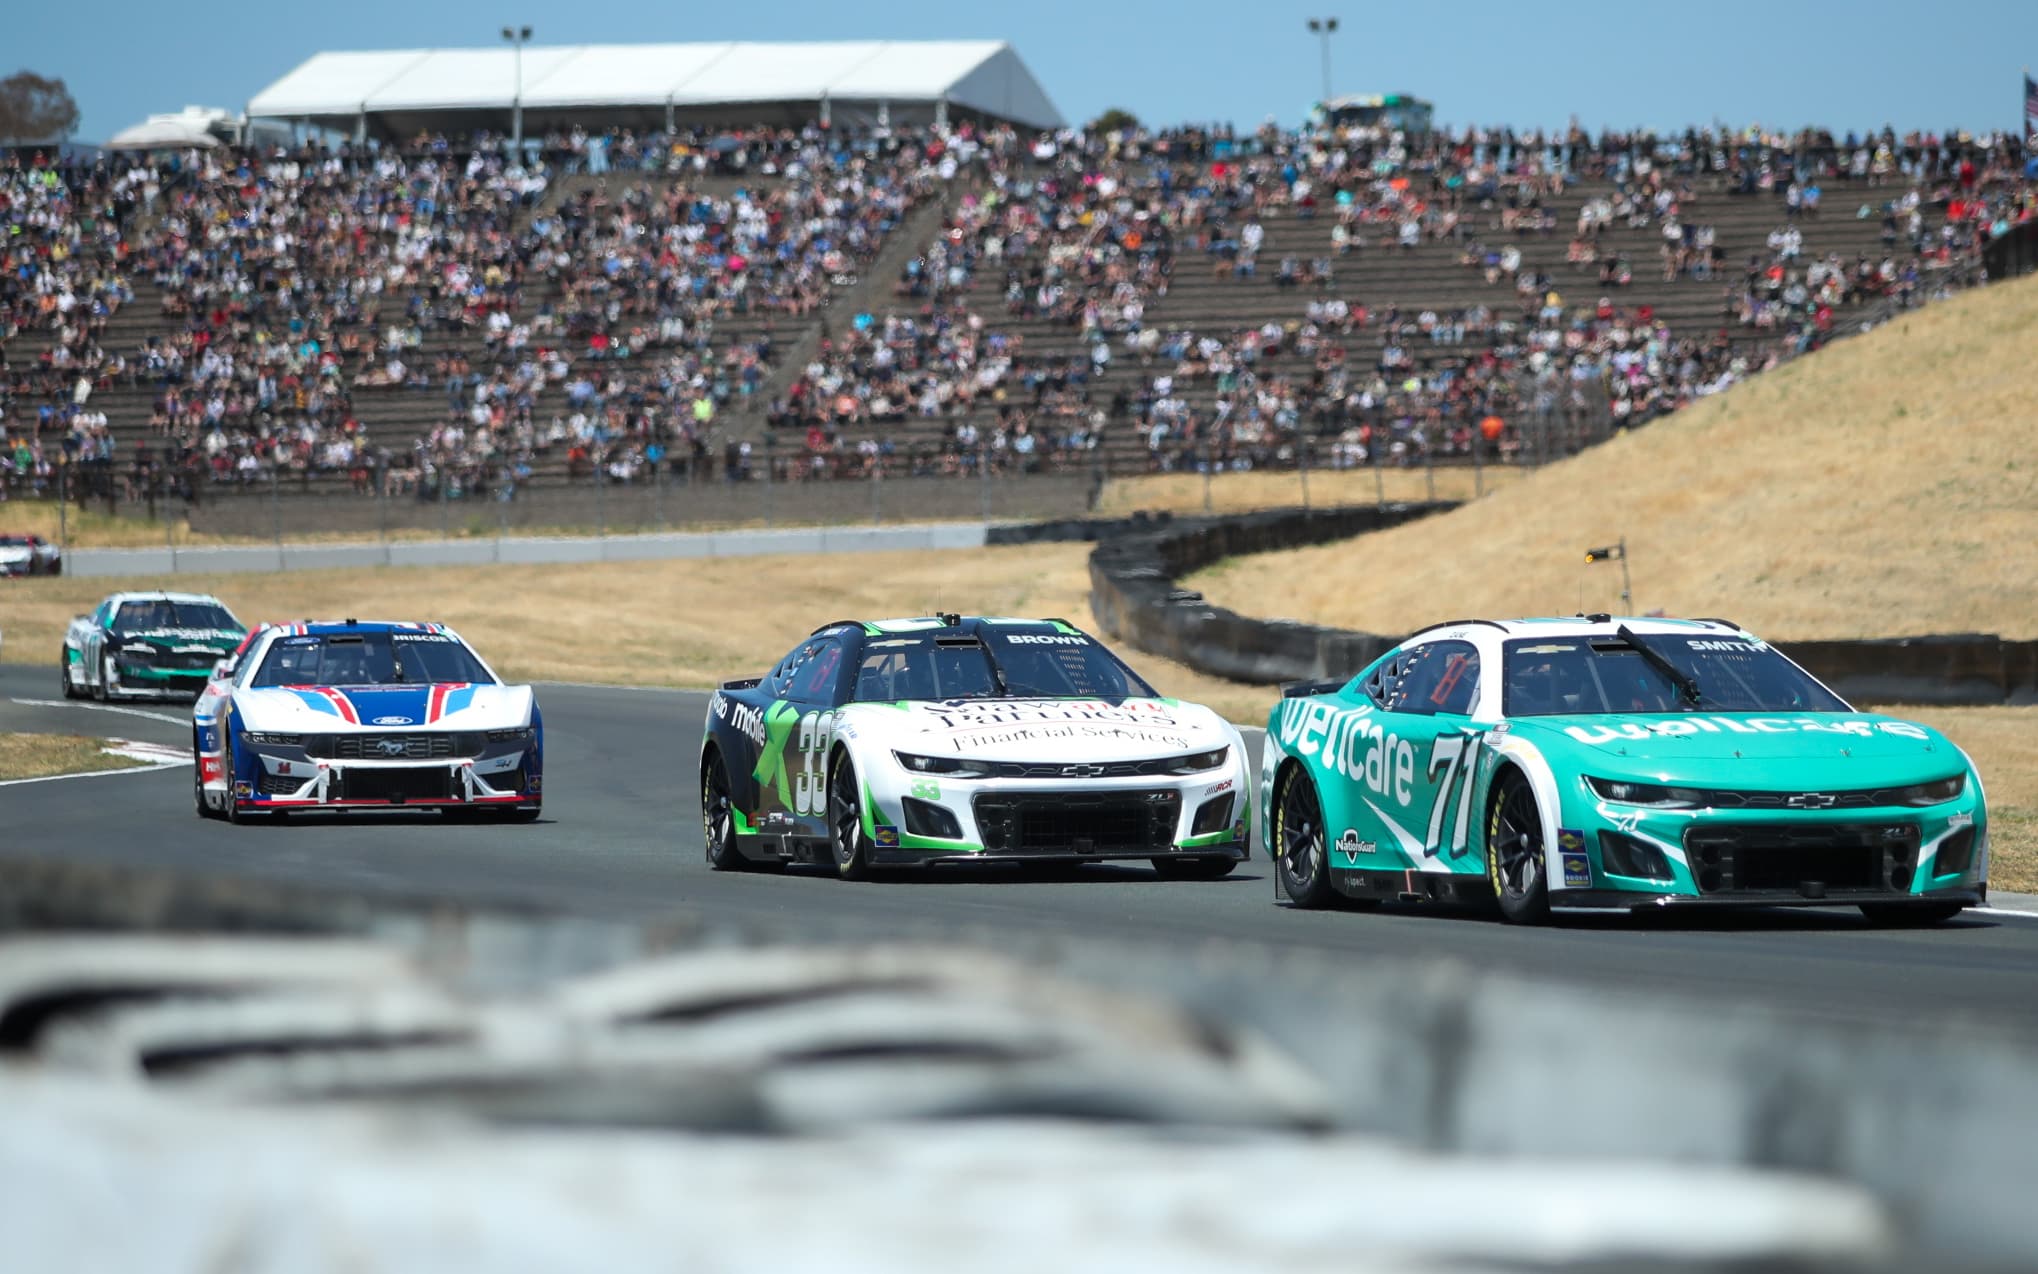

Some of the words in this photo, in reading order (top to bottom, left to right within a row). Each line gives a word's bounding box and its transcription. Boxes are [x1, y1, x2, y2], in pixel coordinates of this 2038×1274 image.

[1006, 634, 1089, 645] BROWN
[1686, 640, 1767, 653] SMITH
[731, 703, 766, 747] mobile
[952, 726, 1075, 752] Financial
[1081, 726, 1189, 749] Services
[1563, 716, 1930, 744] wellcare
[796, 710, 836, 817] 33
[1281, 698, 1414, 807] wellcare
[911, 778, 941, 801] 33
[1424, 731, 1485, 859] 71
